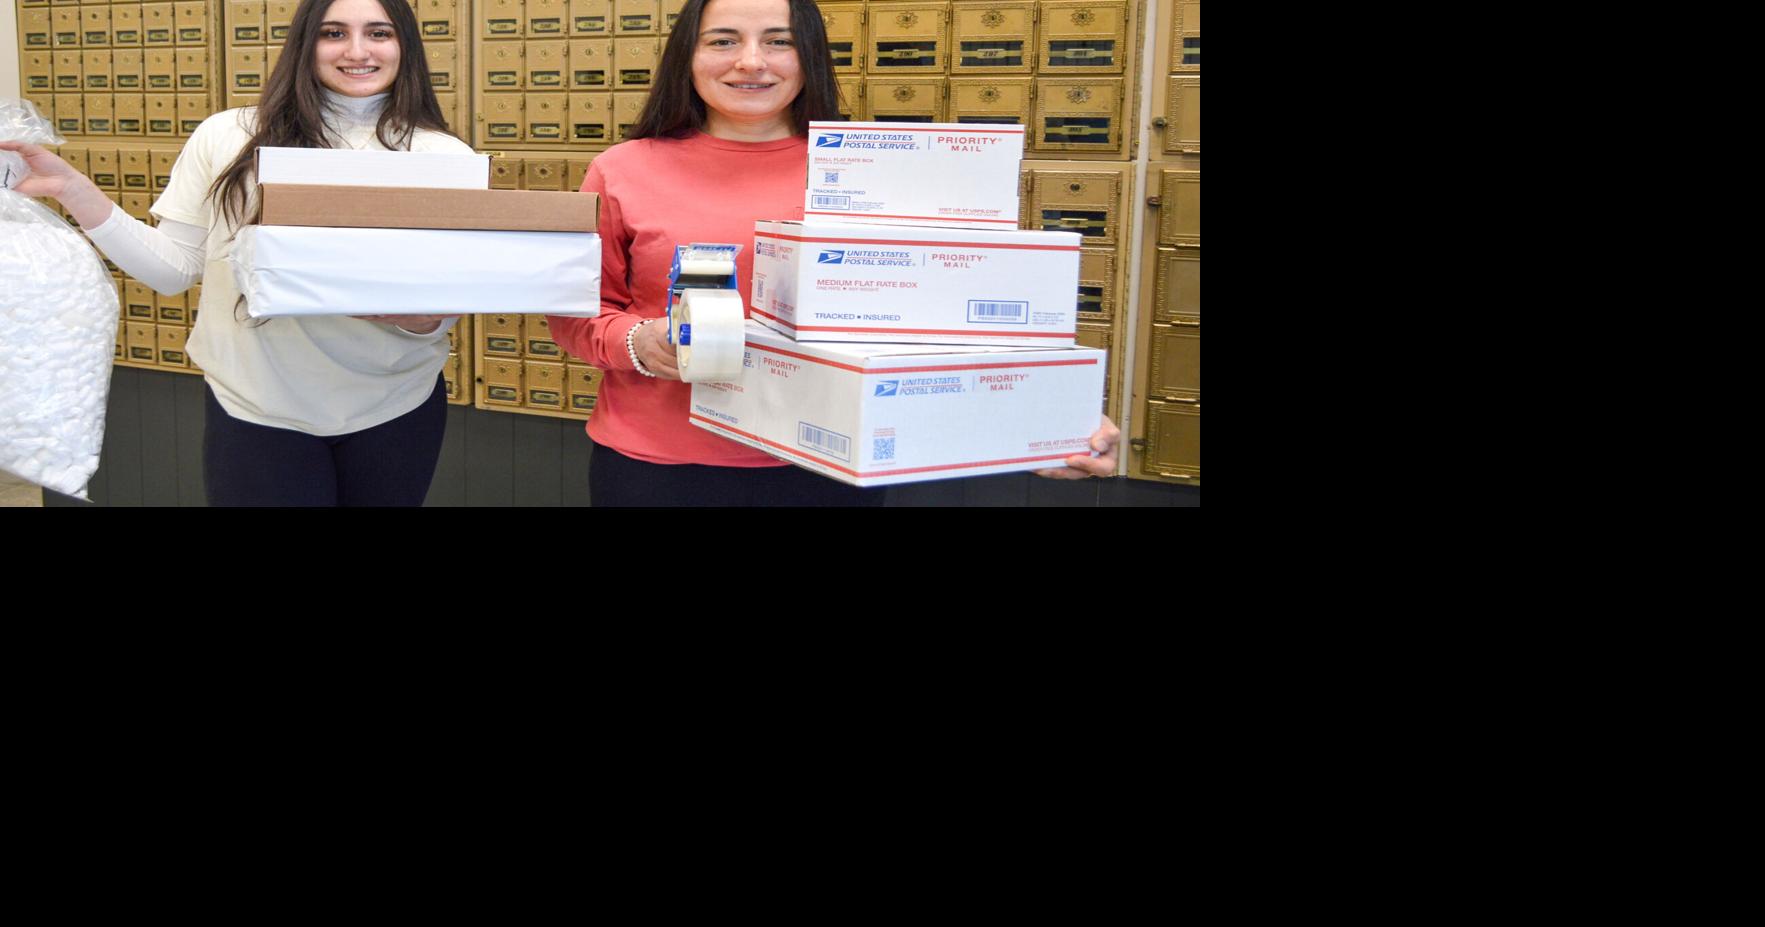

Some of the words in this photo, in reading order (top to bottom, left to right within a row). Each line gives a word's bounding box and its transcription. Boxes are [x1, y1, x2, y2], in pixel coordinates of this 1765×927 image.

[846, 133, 880, 141] UNITED
[844, 258, 875, 266] POSTAL
[816, 279, 852, 287] MEDIUM
[876, 280, 897, 288] RATE
[815, 312, 855, 320] TRACKED
[863, 313, 901, 321] INSURED
[770, 367, 789, 378] MAIL
[901, 378, 932, 386] UNITED
[933, 376, 961, 385] STATES
[900, 386, 929, 396] POSTAL
[990, 383, 1014, 391] MAIL
